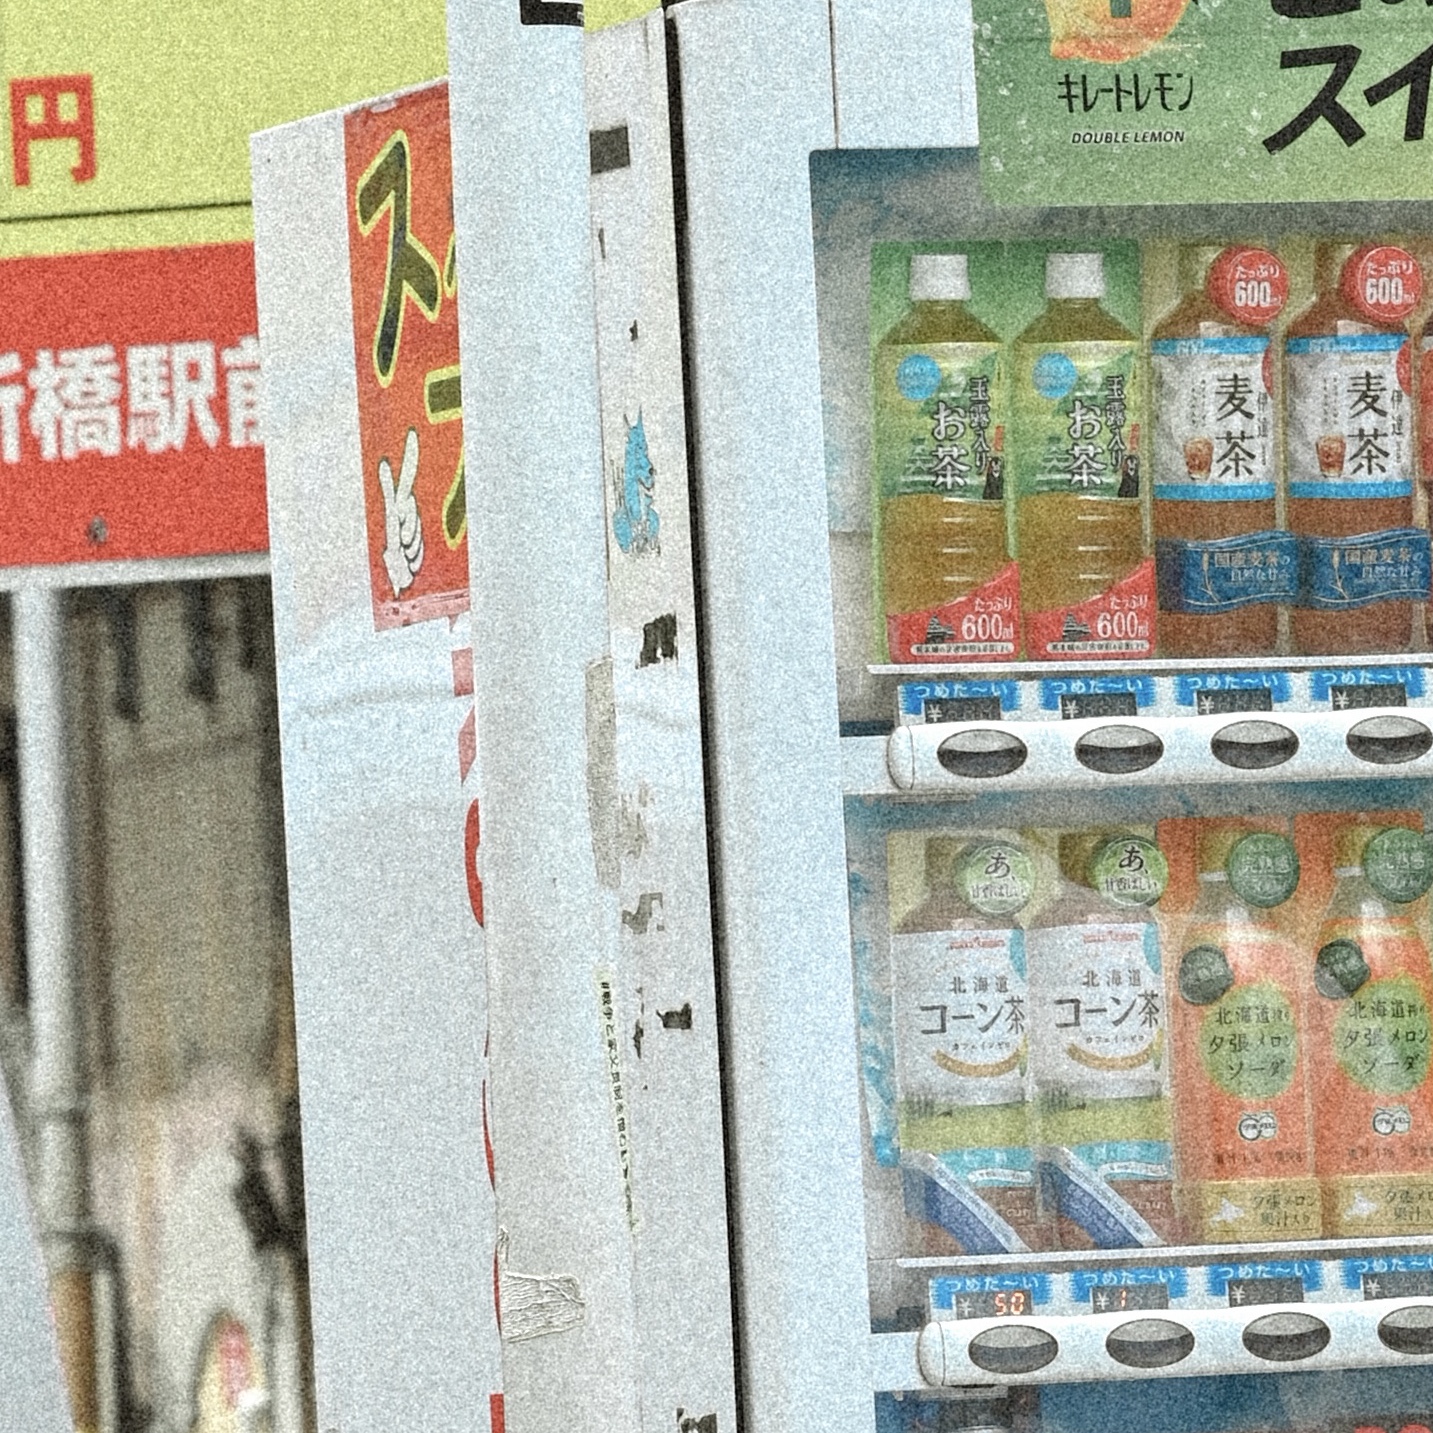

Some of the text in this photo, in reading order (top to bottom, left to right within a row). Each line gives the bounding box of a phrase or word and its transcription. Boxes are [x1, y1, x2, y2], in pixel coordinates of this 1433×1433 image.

[1056, 73, 1195, 114] キレートレモン
[9, 74, 97, 187] 円
[1071, 129, 1185, 145] DOUBLE LEMON
[1235, 265, 1280, 279] たっぷり
[1366, 260, 1413, 274] たっぷり
[0, 335, 264, 463] 橋駅
[1214, 373, 1257, 478] 麦茶
[1348, 371, 1391, 476] 麦茶
[933, 400, 971, 489] お茶
[1069, 400, 1106, 488] お茶
[974, 597, 1012, 612] たっぷり
[1109, 596, 1148, 610] たっぷり
[949, 977, 1010, 995] 北海道
[1082, 971, 1143, 988] 北海道
[920, 997, 1026, 1035] コーン茶
[1055, 991, 1160, 1029] コーン茶
[1228, 1059, 1286, 1081] ソーダ
[1363, 1054, 1420, 1075] ソーダ
